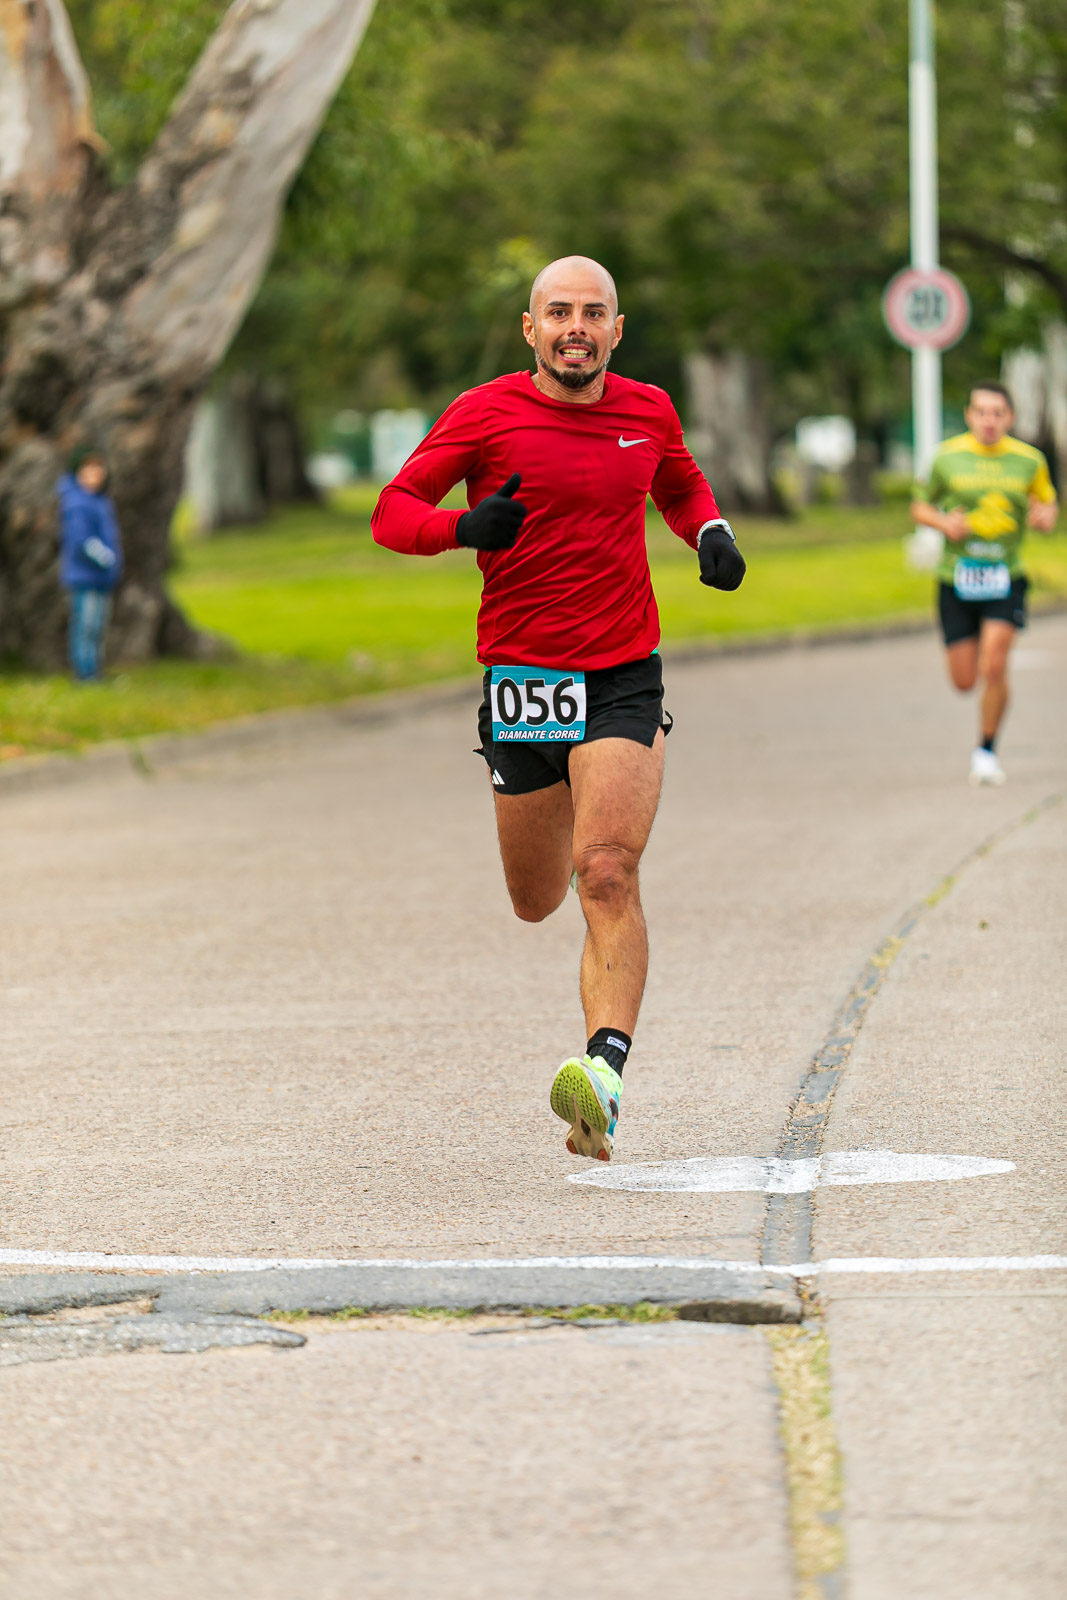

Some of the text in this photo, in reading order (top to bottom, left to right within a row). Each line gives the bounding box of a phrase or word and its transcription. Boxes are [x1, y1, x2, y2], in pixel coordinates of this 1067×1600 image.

[496, 677, 578, 727] 056
[497, 729, 581, 740] DIAMANTE CORRE
